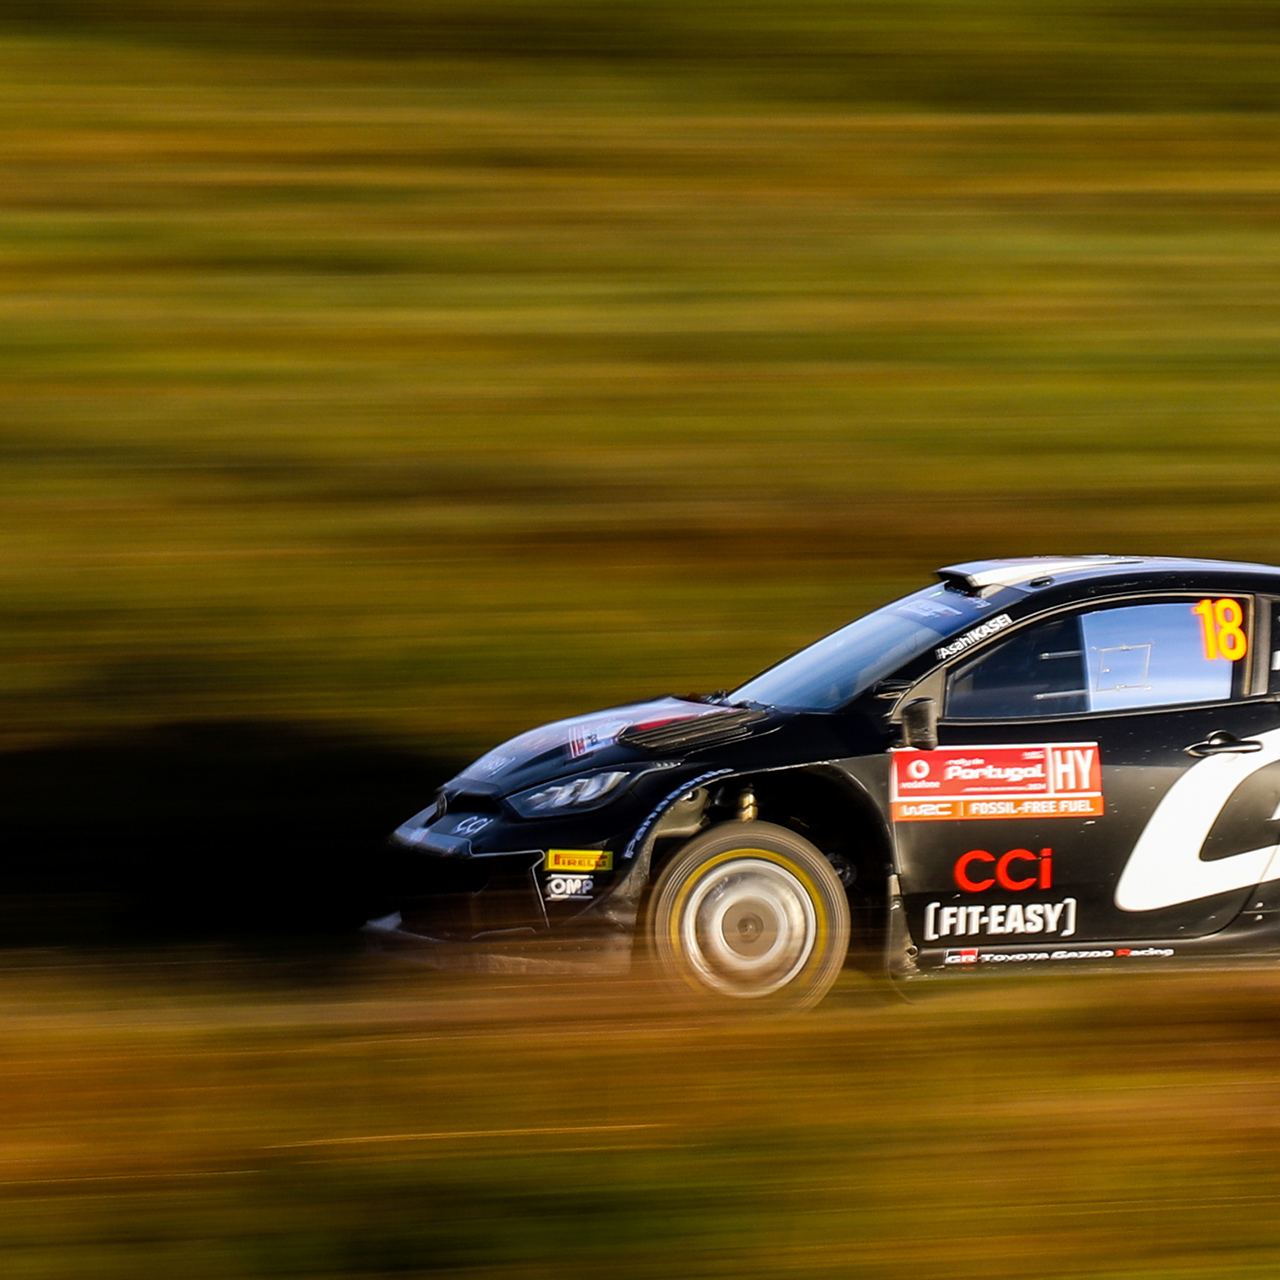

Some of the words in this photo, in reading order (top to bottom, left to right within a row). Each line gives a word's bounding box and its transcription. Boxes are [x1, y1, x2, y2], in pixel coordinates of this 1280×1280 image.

[1192, 598, 1248, 661] 18
[945, 763, 1046, 782] Portugal
[1053, 749, 1094, 790] HY
[900, 780, 940, 789] vodafone
[902, 803, 952, 815] WRC
[970, 800, 1057, 815] FOSSIL-FREE
[1059, 800, 1094, 813] FUEL
[547, 879, 593, 894] OMP
[980, 952, 1050, 962] TOYOTA
